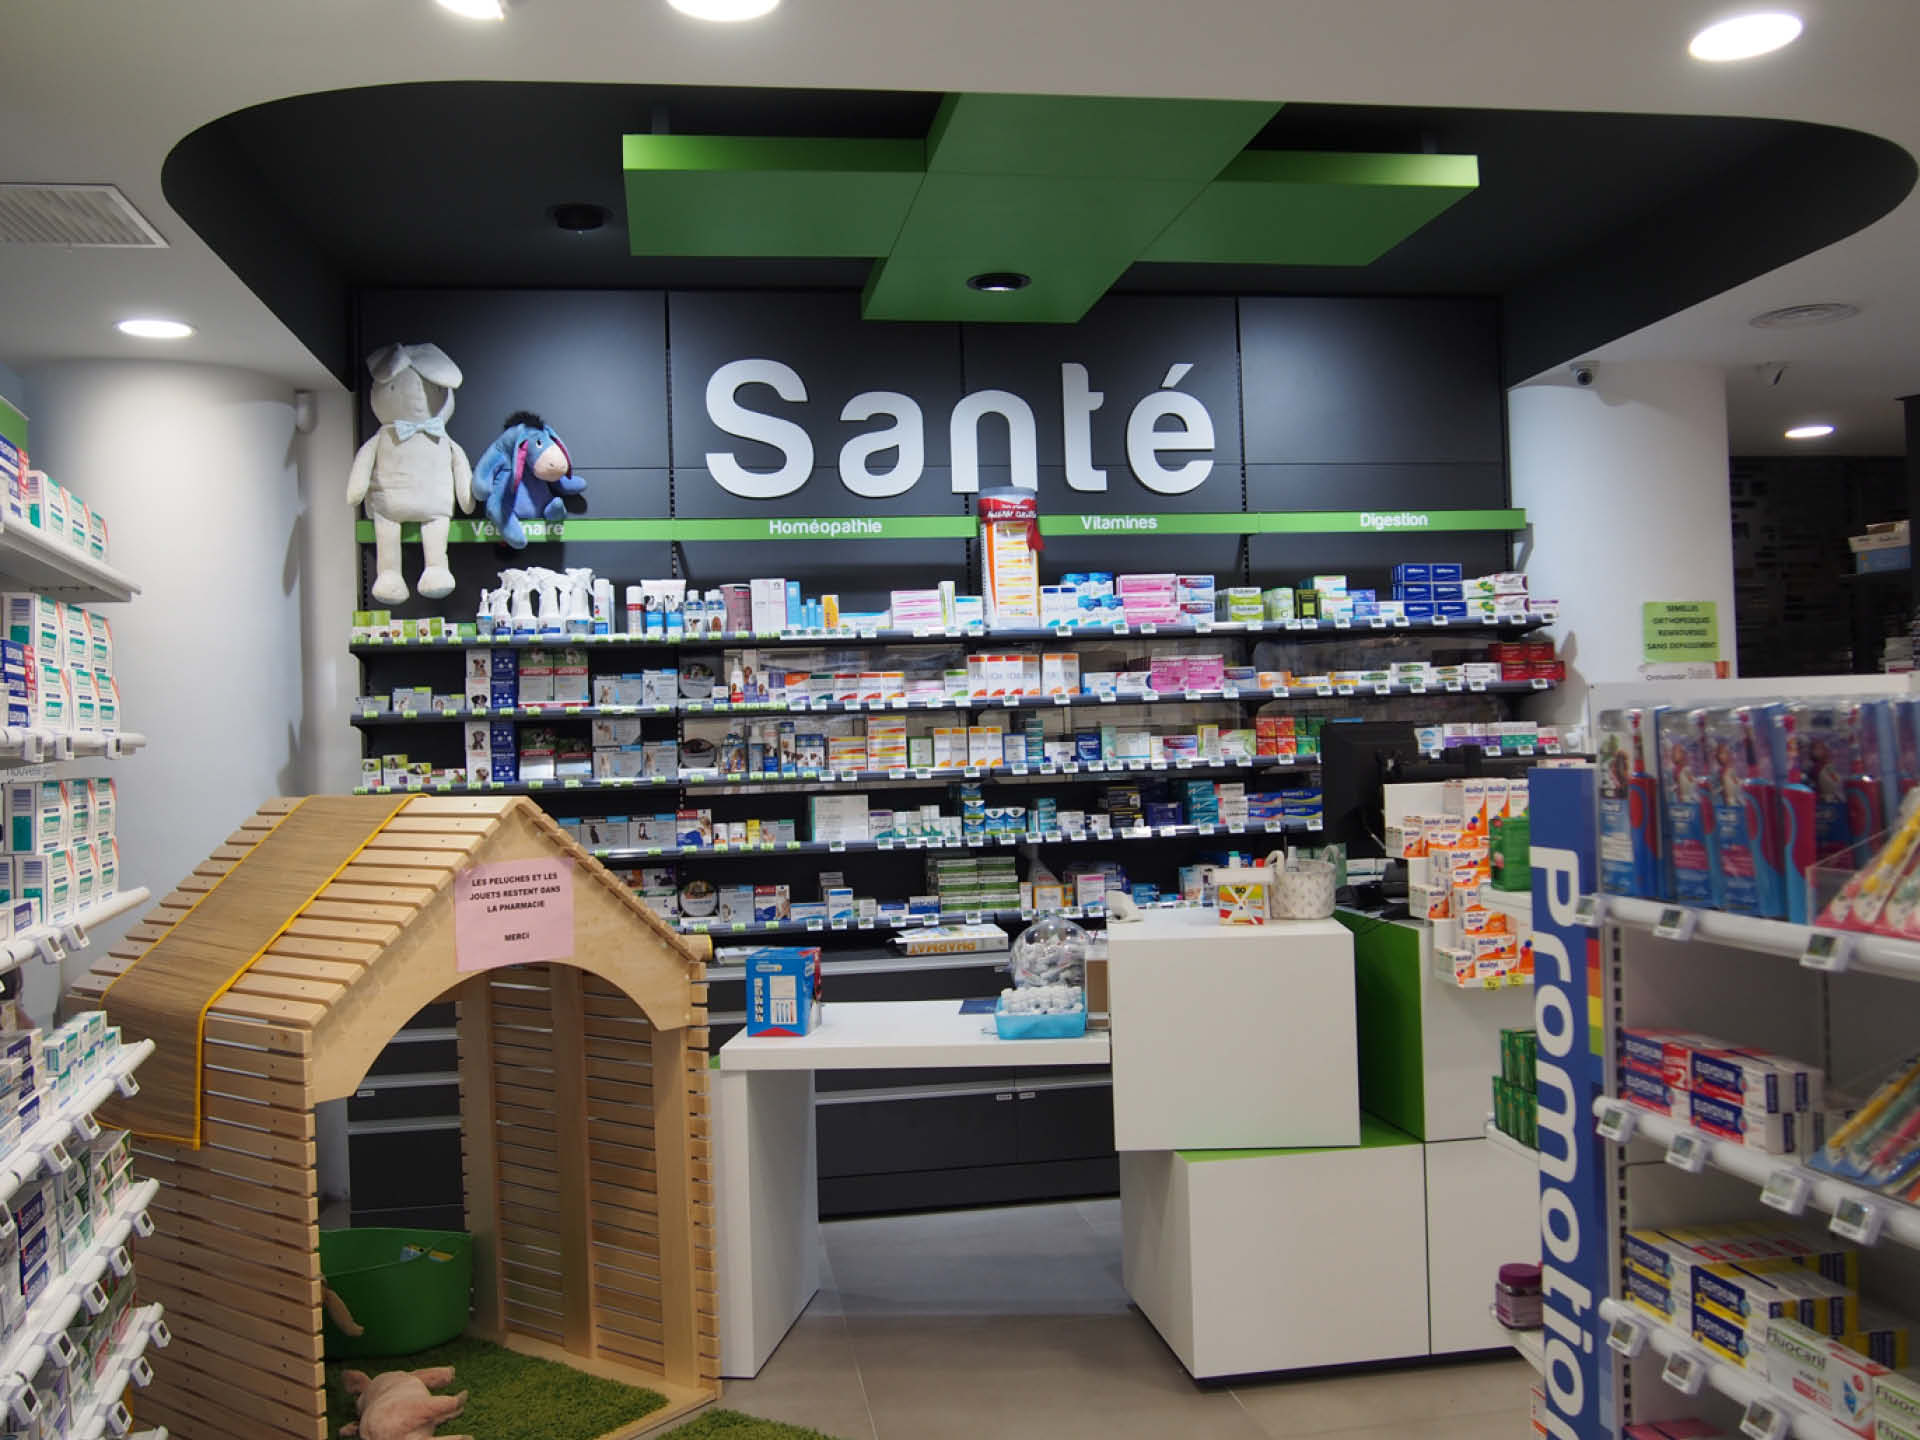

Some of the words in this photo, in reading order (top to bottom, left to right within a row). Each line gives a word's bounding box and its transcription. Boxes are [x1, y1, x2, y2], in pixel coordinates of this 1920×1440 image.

[705, 358, 1215, 498] Santé
[769, 518, 882, 537] Homéopathie
[1081, 515, 1158, 530] Vitamines
[1360, 512, 1429, 531] Digestion
[472, 878, 487, 887] LES
[489, 875, 530, 886] PELUCHES
[532, 873, 542, 882] ET
[543, 871, 558, 881] LES
[469, 891, 501, 901] JOUETS
[503, 888, 539, 898] RESTENT
[540, 885, 561, 895] DANS
[487, 905, 498, 913] LA
[499, 900, 545, 912] PHARMACIE
[504, 932, 530, 942] MERCI
